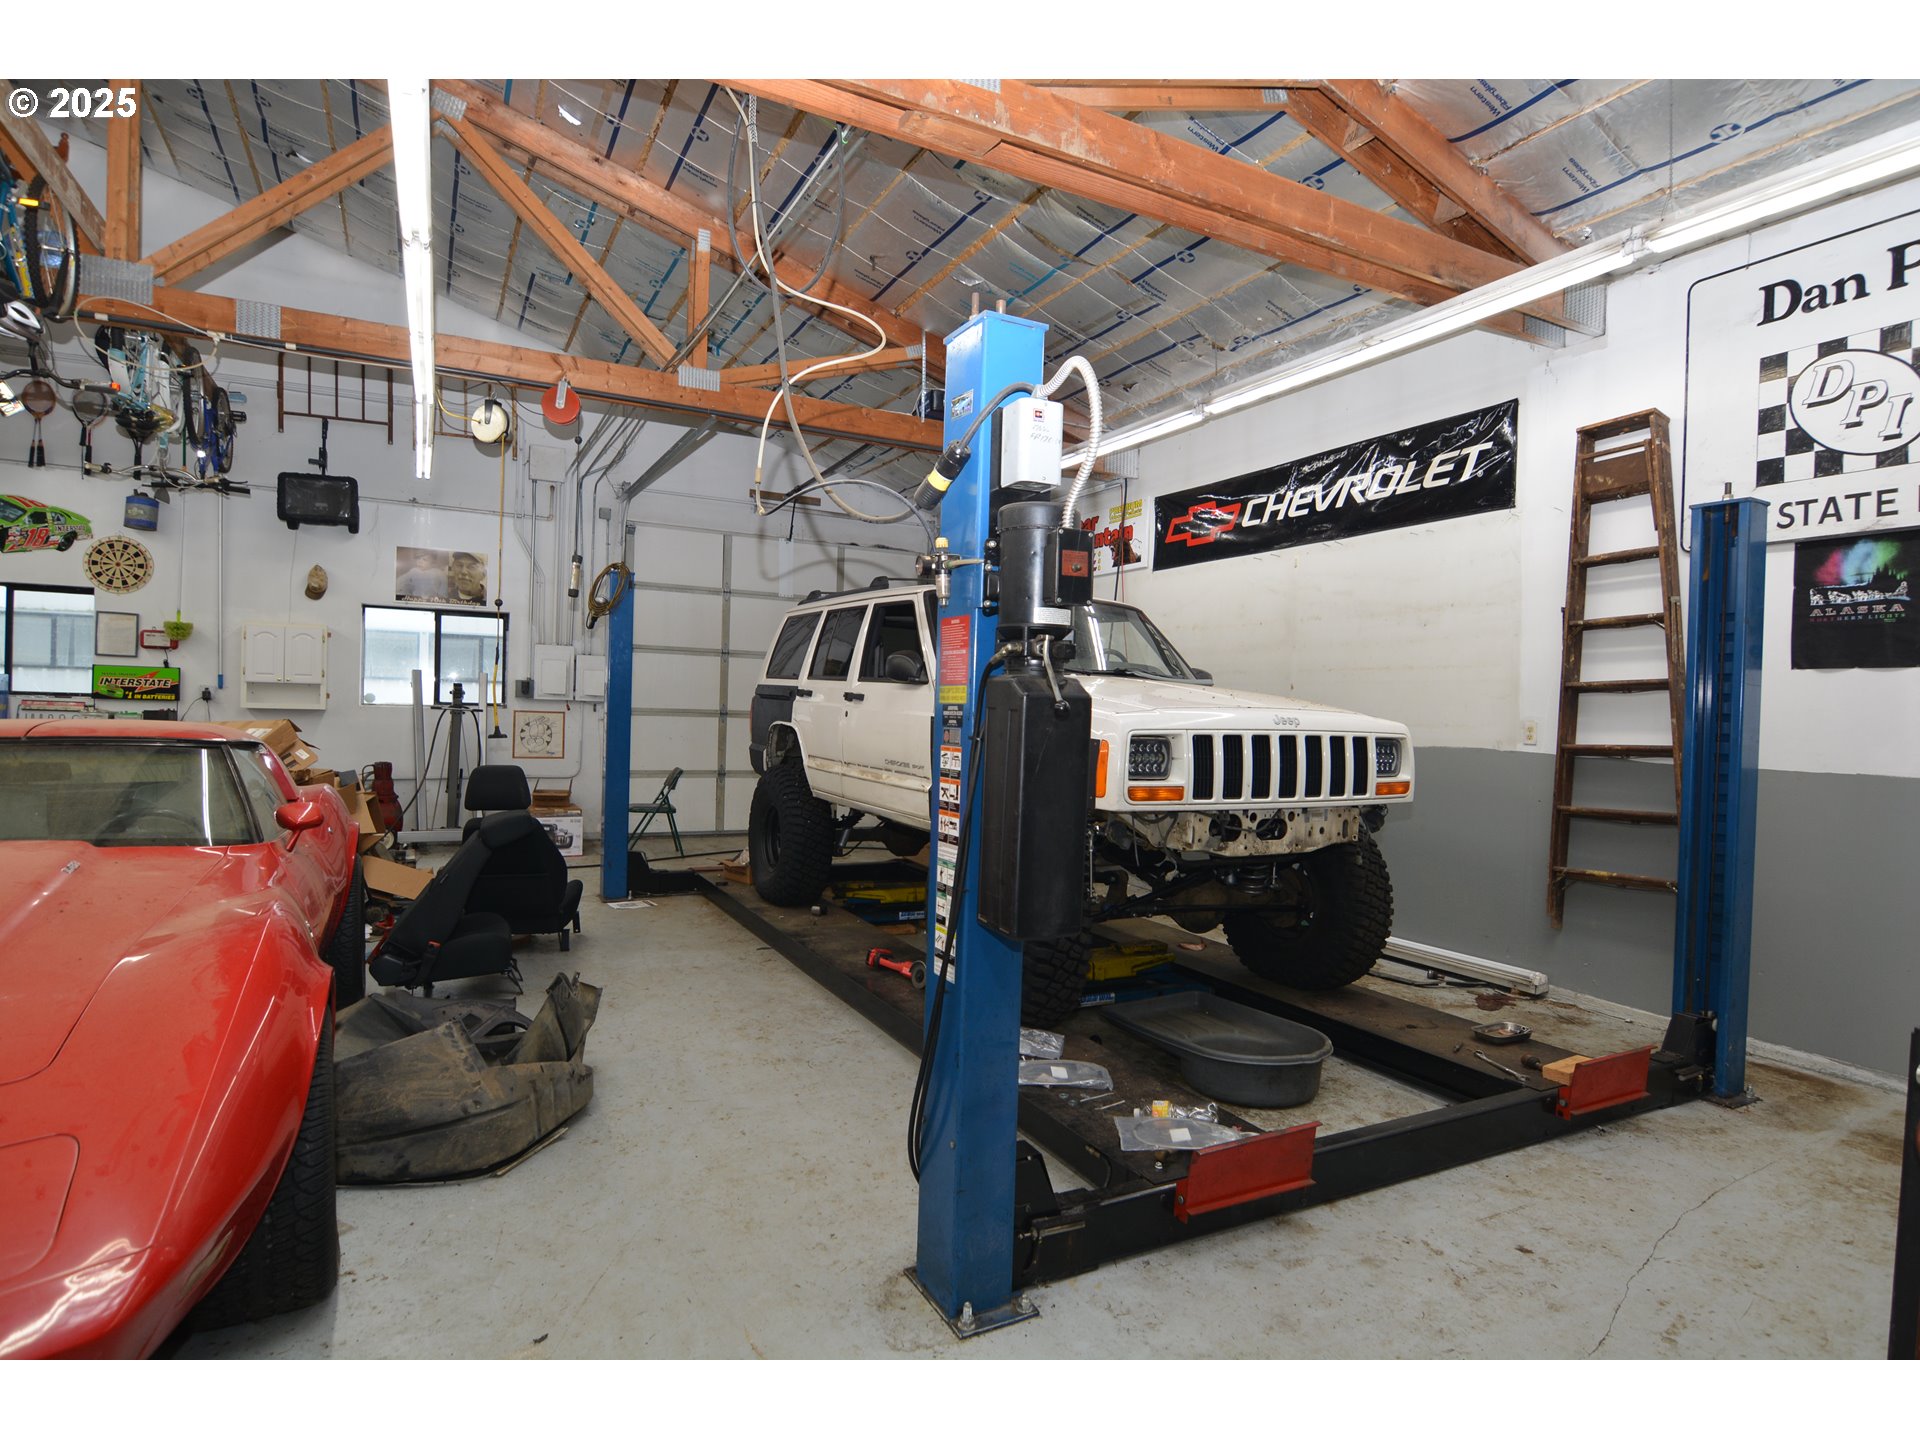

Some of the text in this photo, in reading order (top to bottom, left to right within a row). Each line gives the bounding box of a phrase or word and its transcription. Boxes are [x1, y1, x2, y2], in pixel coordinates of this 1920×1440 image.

[1470, 86, 1501, 117] Western
[1477, 79, 1512, 110] Fiberglas
[1188, 126, 1219, 152] Western
[1562, 167, 1589, 194] Western
[1568, 157, 1601, 189] Fiberglass
[1757, 279, 1871, 326] Dan
[1802, 360, 1914, 441] DPI
[1242, 442, 1494, 527] CHEVROLET
[1776, 487, 1899, 529] STATE
[23, 528, 50, 547] 18
[1810, 603, 1905, 617] ALASKA
[99, 677, 172, 687] INTERSTATE
[1272, 714, 1300, 728] Jeep
